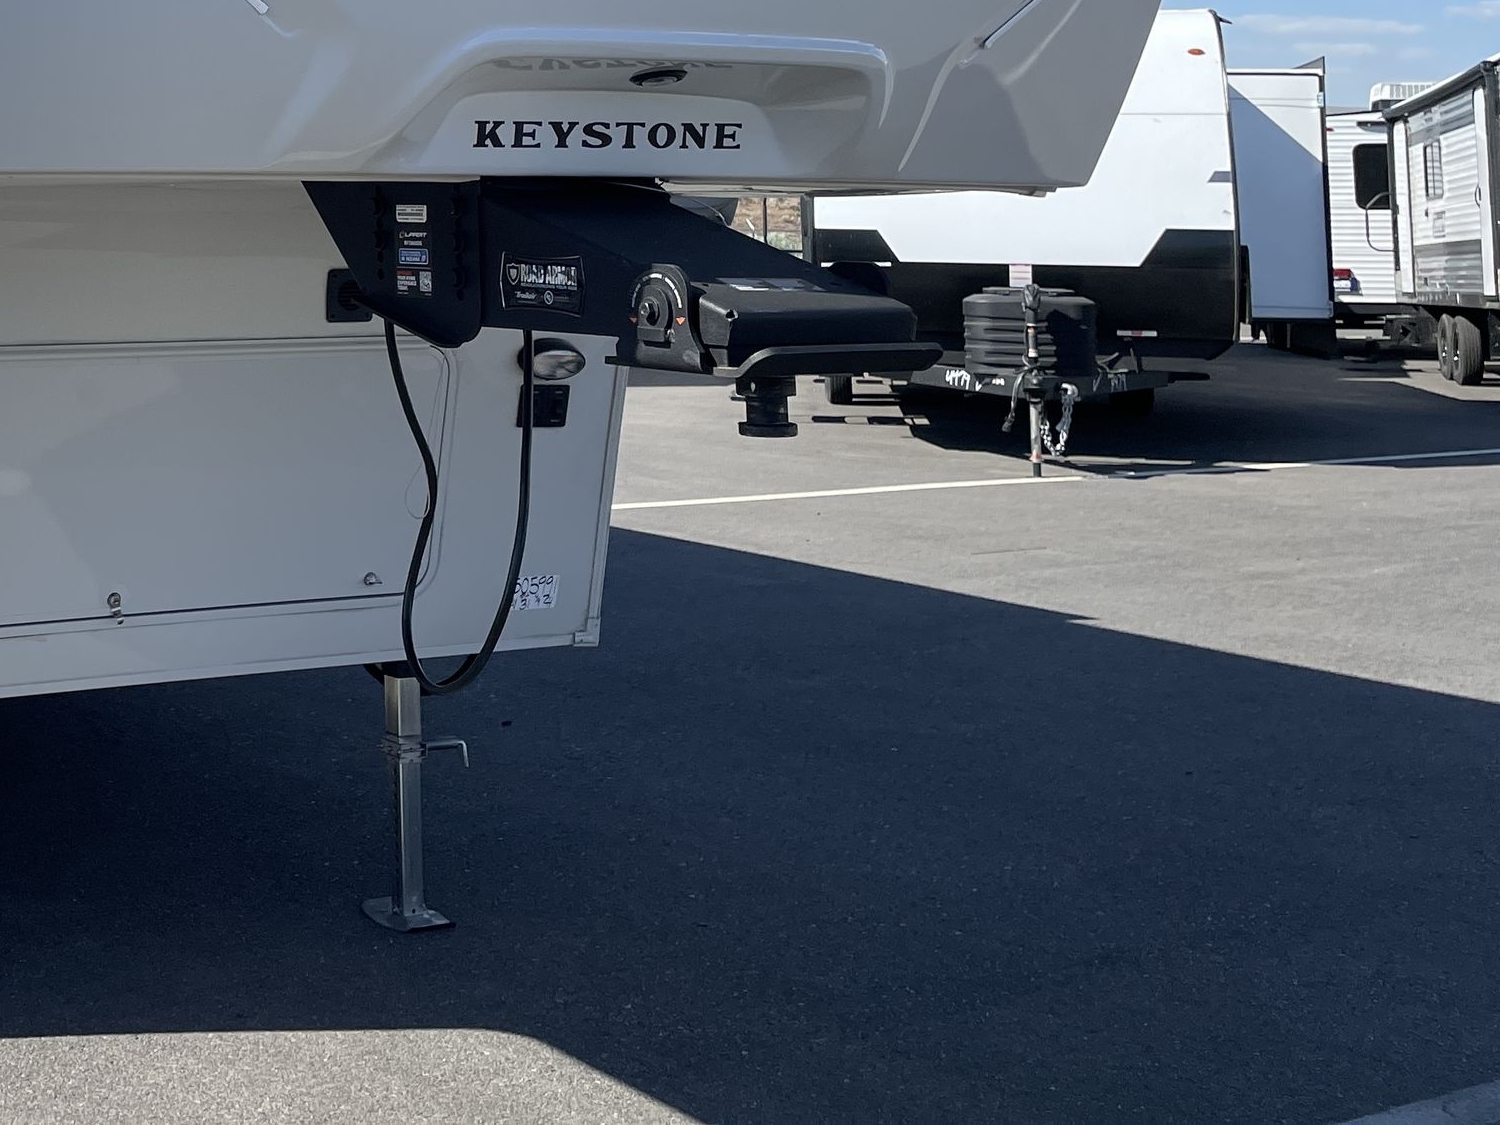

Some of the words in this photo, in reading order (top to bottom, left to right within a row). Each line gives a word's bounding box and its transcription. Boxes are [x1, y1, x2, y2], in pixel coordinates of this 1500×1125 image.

[472, 120, 743, 149] KEYSTONE
[520, 263, 545, 284] ROAD
[545, 265, 578, 286] ARMOR
